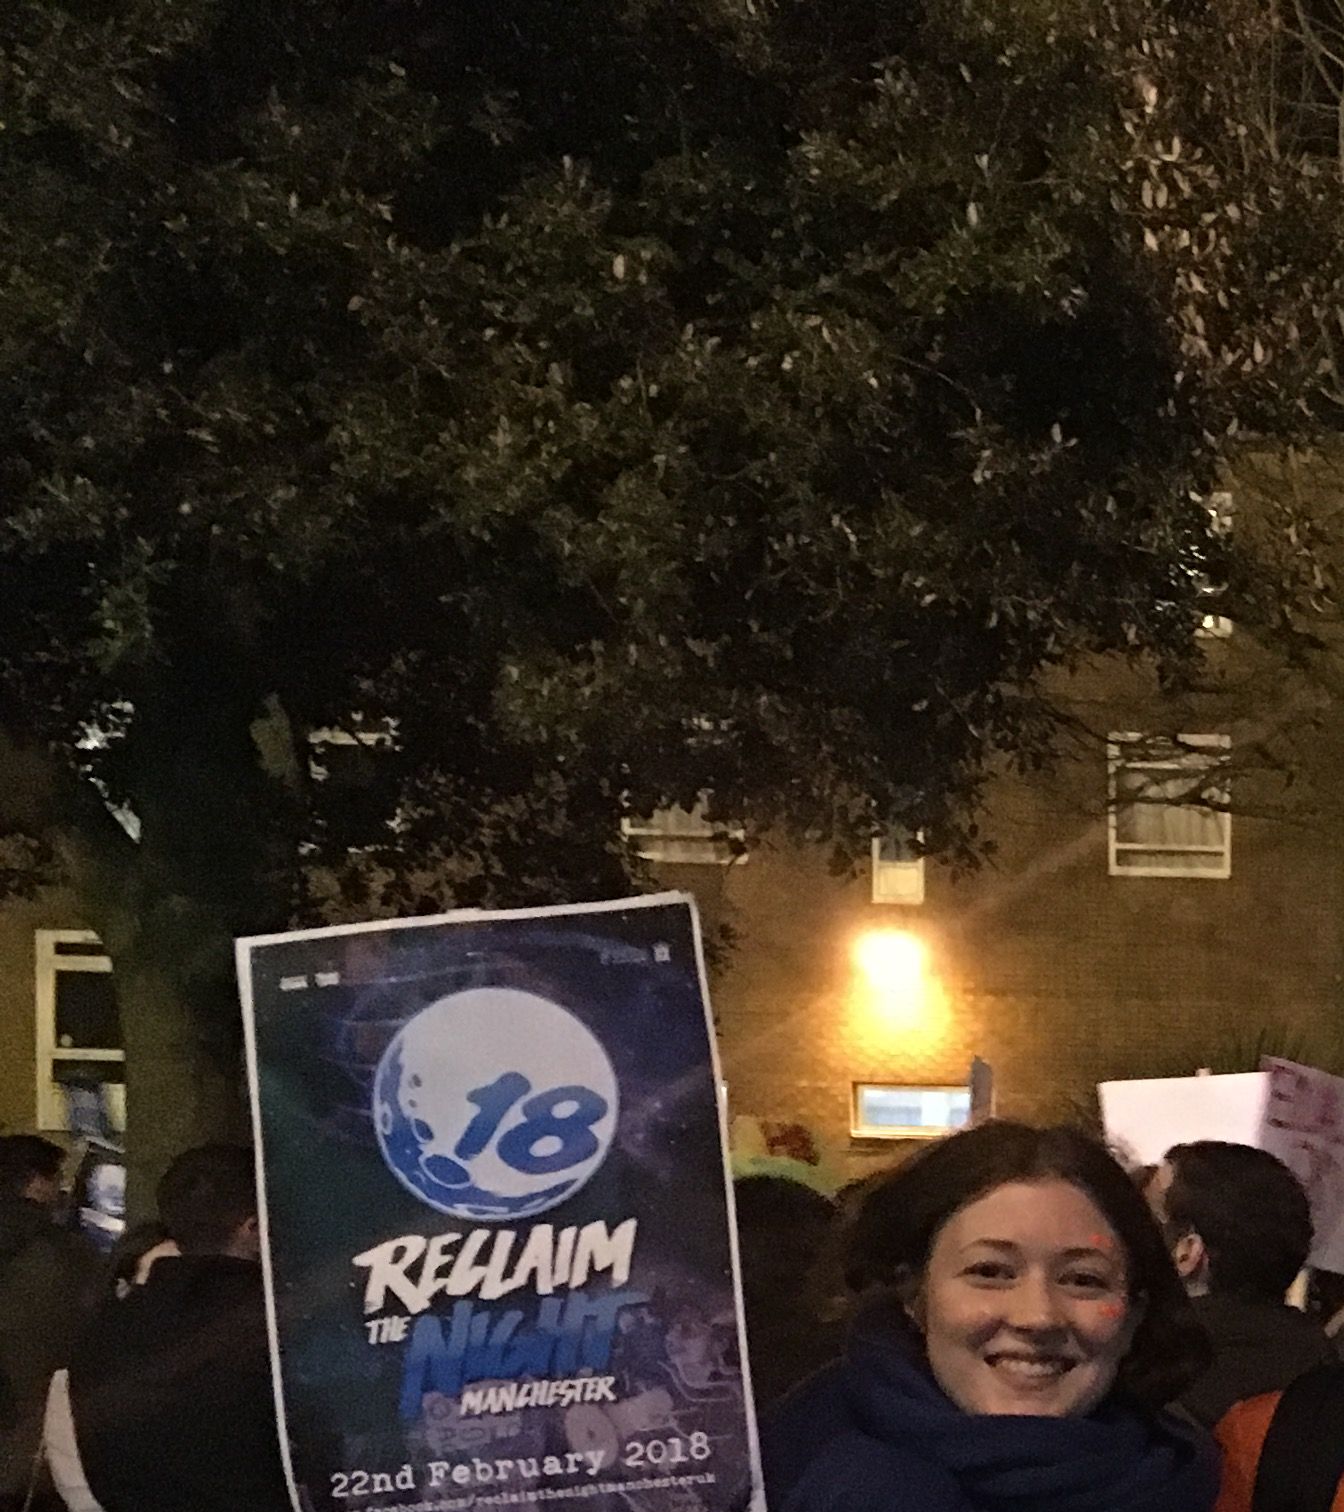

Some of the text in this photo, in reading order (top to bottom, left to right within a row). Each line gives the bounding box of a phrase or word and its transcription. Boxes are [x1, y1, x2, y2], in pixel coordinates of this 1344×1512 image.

[455, 1071, 609, 1174] 18
[352, 1217, 637, 1315] RECLAIM
[365, 1290, 651, 1420] THE NIGHT
[460, 1376, 617, 1416] MANCHESTER
[330, 1431, 712, 1498] 22nd February 2018
